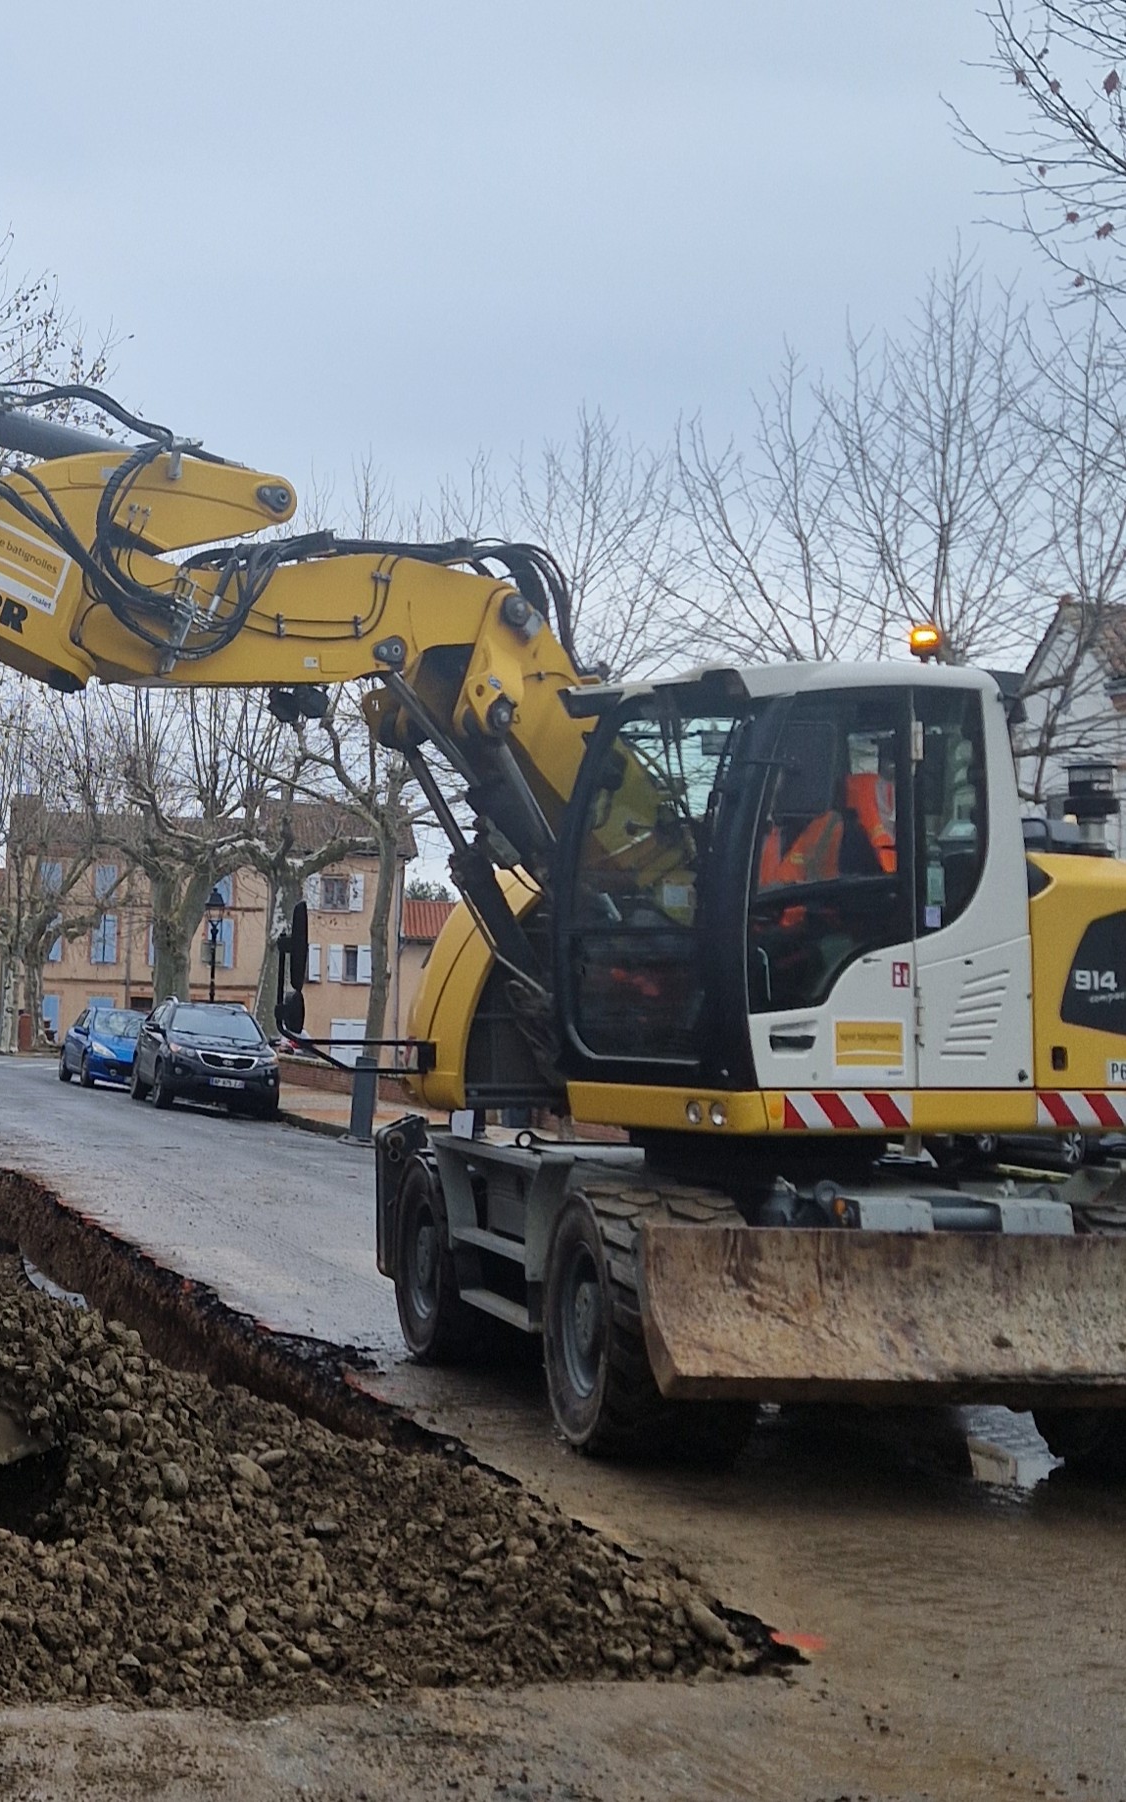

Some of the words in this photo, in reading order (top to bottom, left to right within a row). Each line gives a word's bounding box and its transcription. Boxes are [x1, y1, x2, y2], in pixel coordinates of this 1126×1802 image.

[6, 541, 58, 574] batignolles
[31, 595, 51, 609] malet
[1075, 970, 1118, 991] 914
